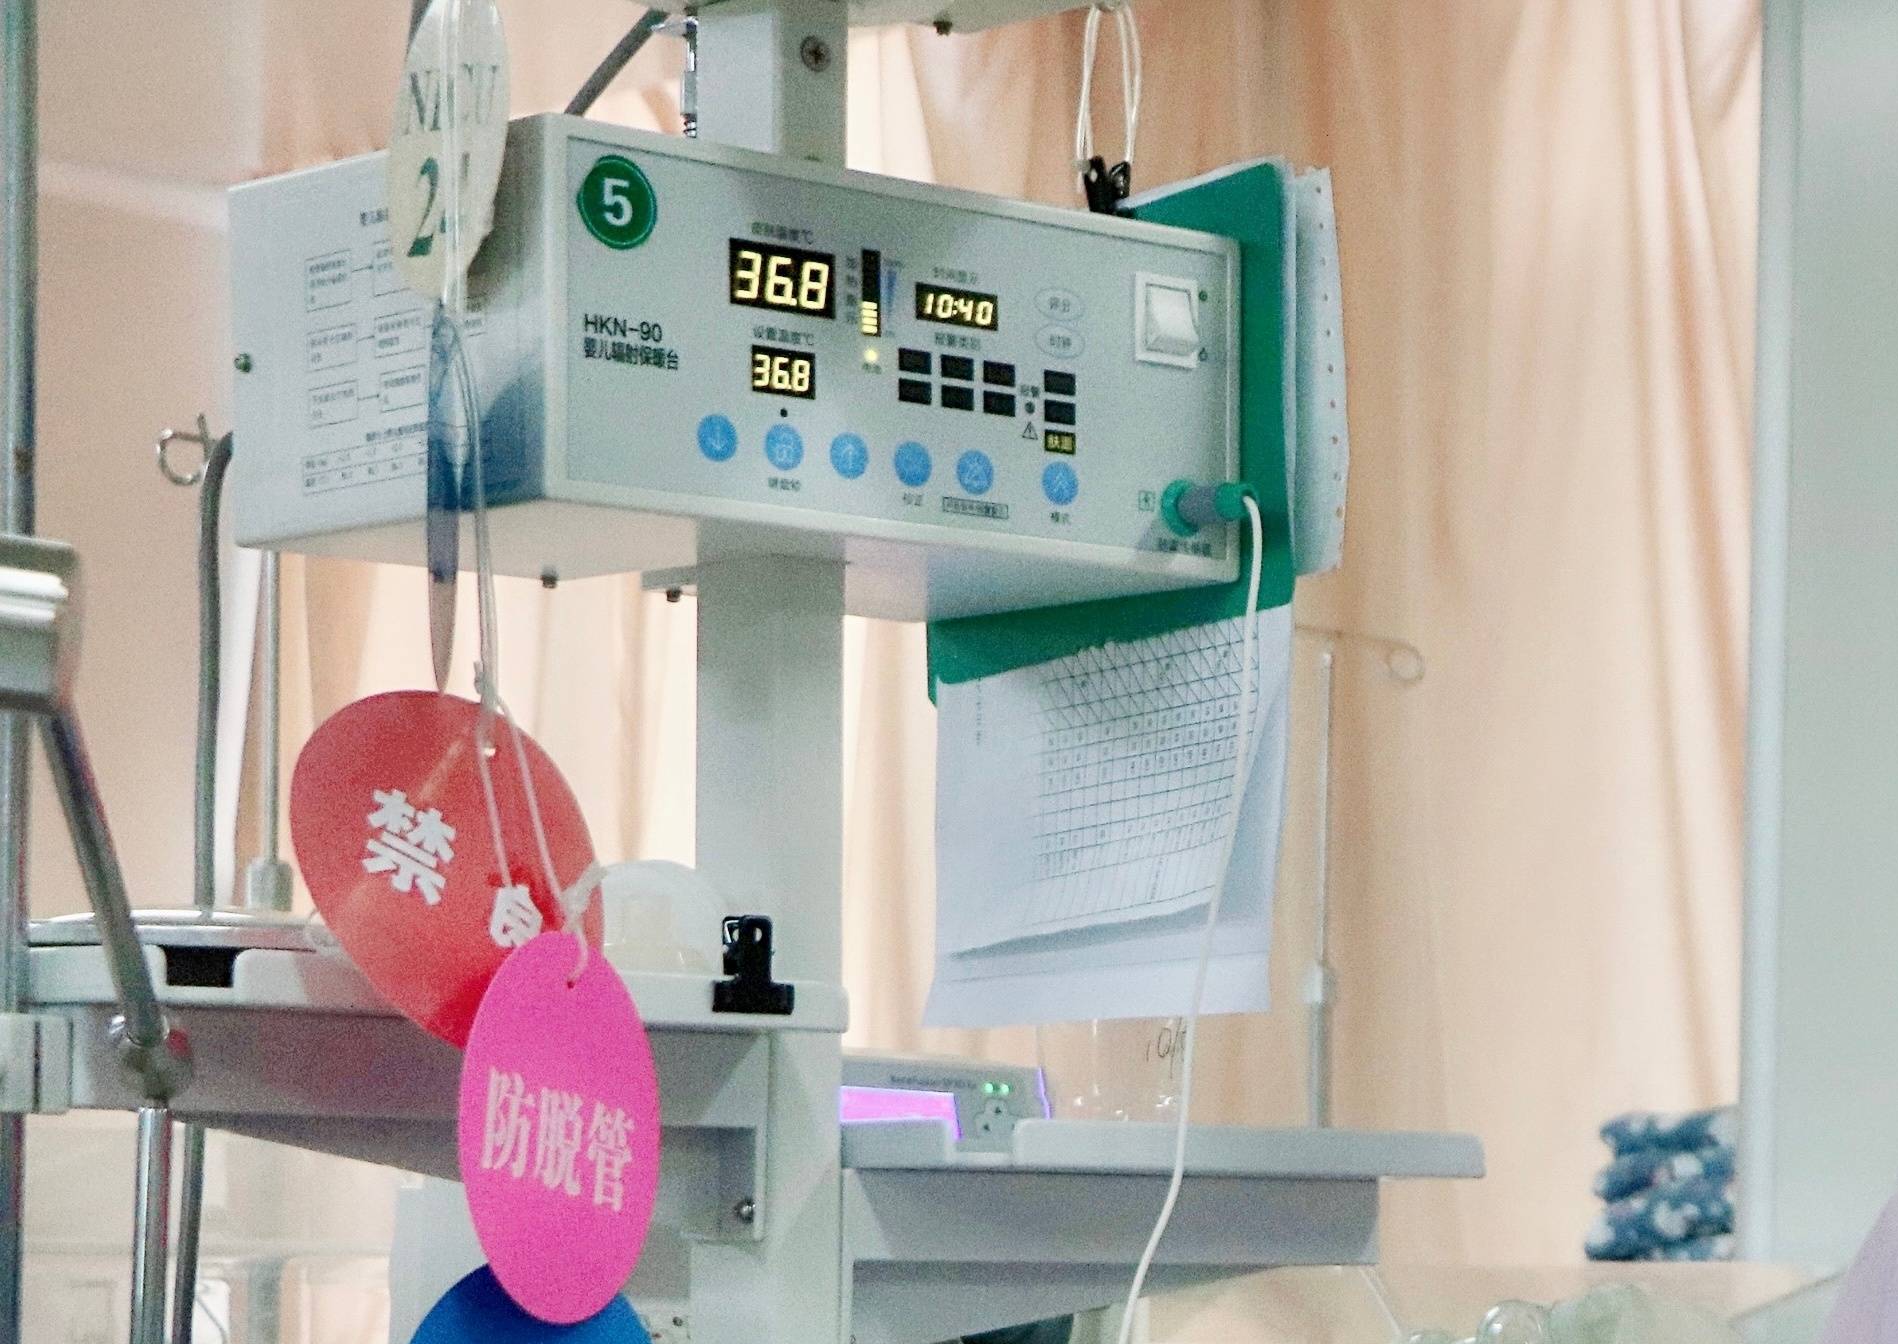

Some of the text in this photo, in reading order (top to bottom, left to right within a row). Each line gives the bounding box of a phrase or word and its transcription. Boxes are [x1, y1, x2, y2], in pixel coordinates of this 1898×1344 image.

[602, 178, 633, 227] 5
[734, 250, 830, 310] 36.8
[583, 313, 663, 343] HKN-90
[924, 293, 993, 326] 10:40
[753, 353, 811, 392] 36.8
[481, 1067, 640, 1213] 防脱管
